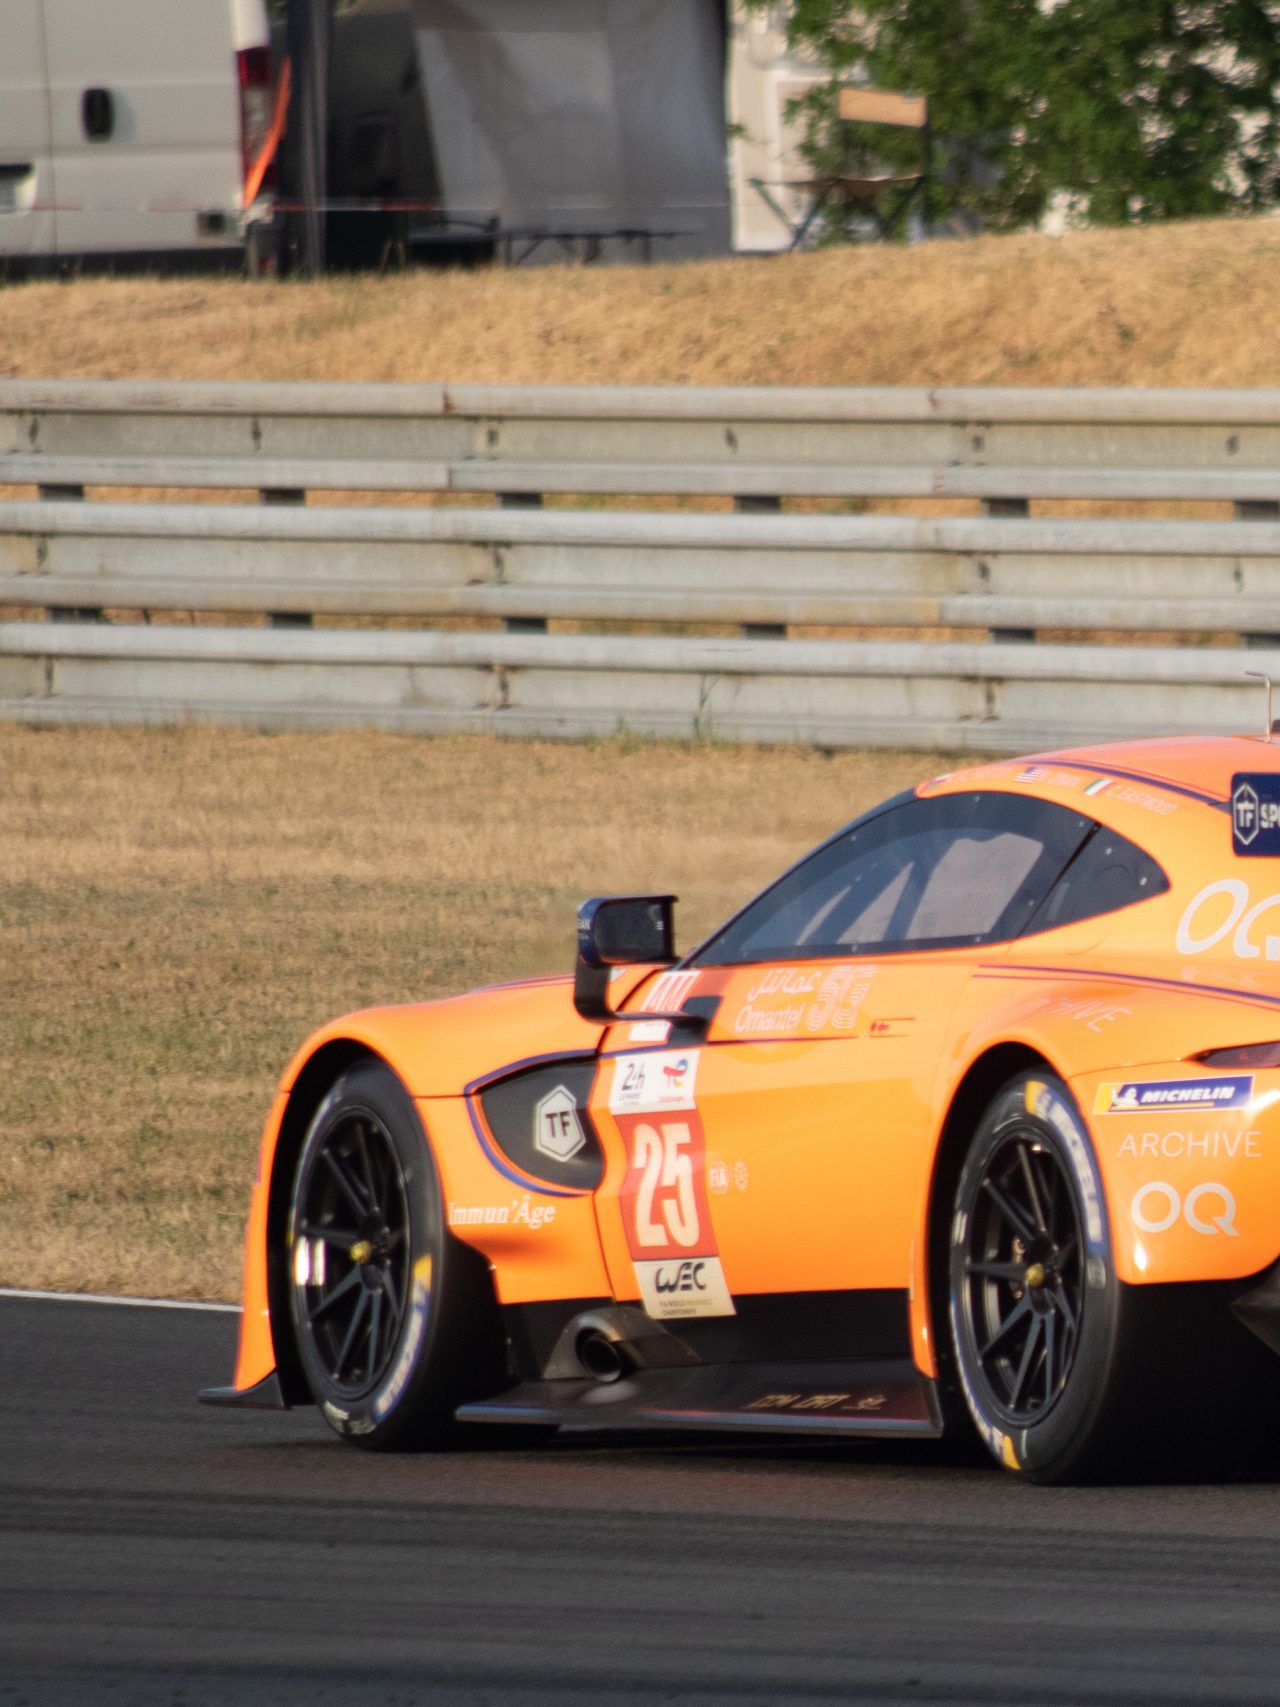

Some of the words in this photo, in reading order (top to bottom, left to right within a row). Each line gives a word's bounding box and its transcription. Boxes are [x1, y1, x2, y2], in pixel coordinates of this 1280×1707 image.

[1236, 801, 1254, 828] TF
[734, 1002, 806, 1034] Omantel
[1141, 1085, 1236, 1105] MICHELIN
[545, 1110, 570, 1139] TF
[1117, 1130, 1262, 1159] ARCHIVE
[632, 1122, 701, 1248] 25
[1131, 1180, 1239, 1237] OQ
[655, 1262, 706, 1293] WEC
